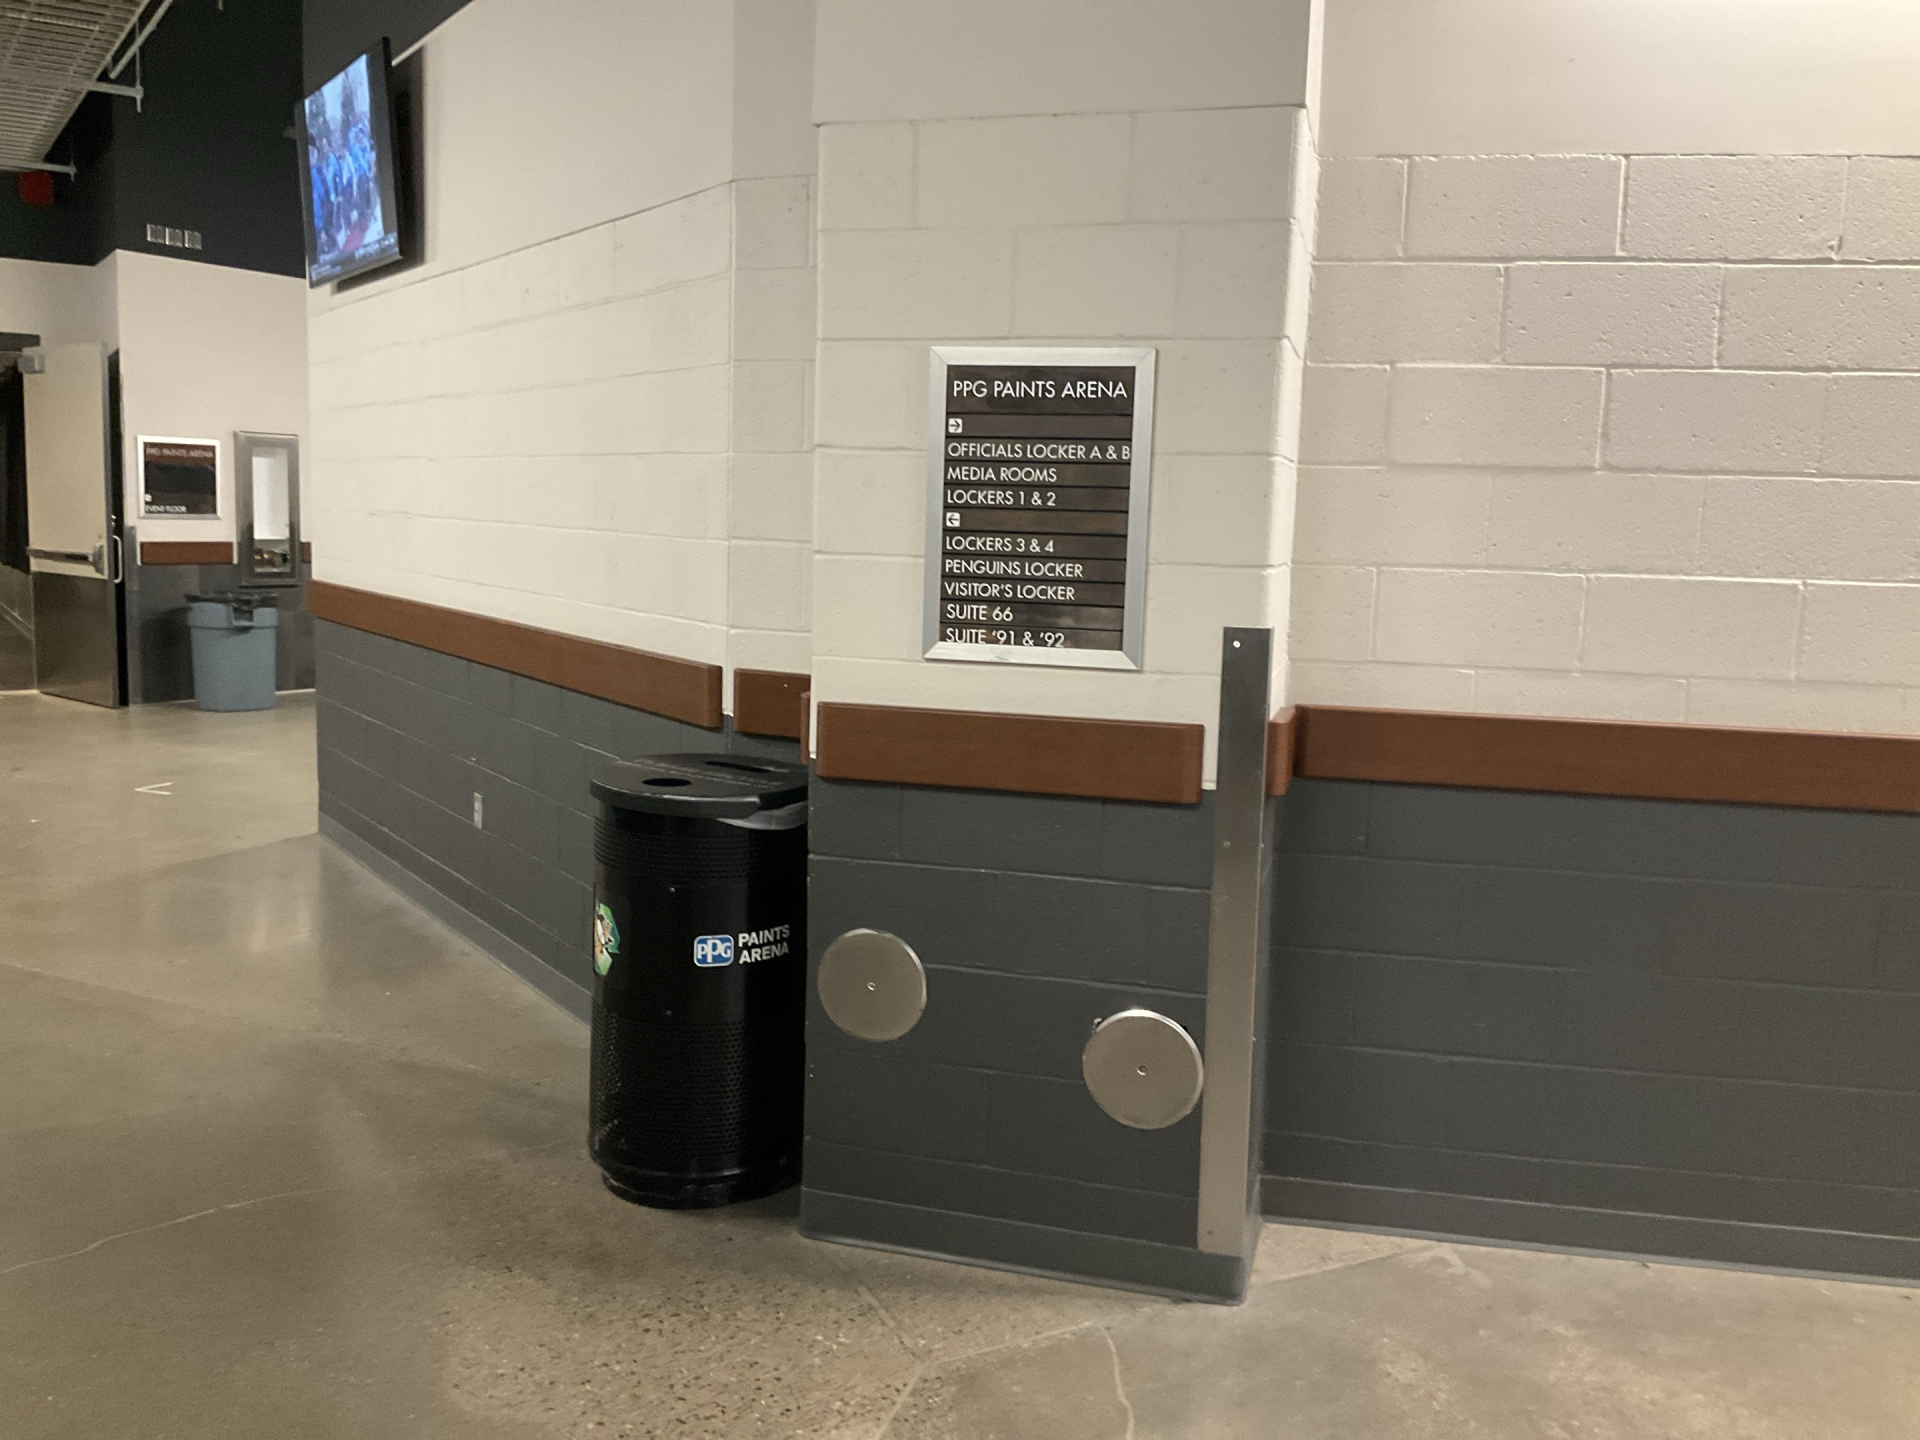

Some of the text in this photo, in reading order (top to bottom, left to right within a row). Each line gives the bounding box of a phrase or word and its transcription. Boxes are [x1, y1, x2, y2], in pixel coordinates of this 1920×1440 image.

[953, 380, 1128, 399] PPG PAINTS ARENA
[947, 442, 1131, 460] OFFICIALS LOCKER A & B
[947, 466, 1058, 483] MEDIA ROOMS
[947, 489, 1056, 507] LOCKERS 1 & 2
[945, 535, 1055, 553] LOCKERS 3 & 4
[944, 559, 1084, 578] PENGUINS LOCKER
[944, 581, 1075, 600] VISITOR'S LOCKER
[946, 603, 1014, 622] SUITE 66
[945, 627, 987, 644] SUITE
[1022, 631, 1035, 647] &
[738, 924, 790, 947] PAINTS
[697, 938, 732, 963] PPG
[738, 941, 789, 964] ARENA
